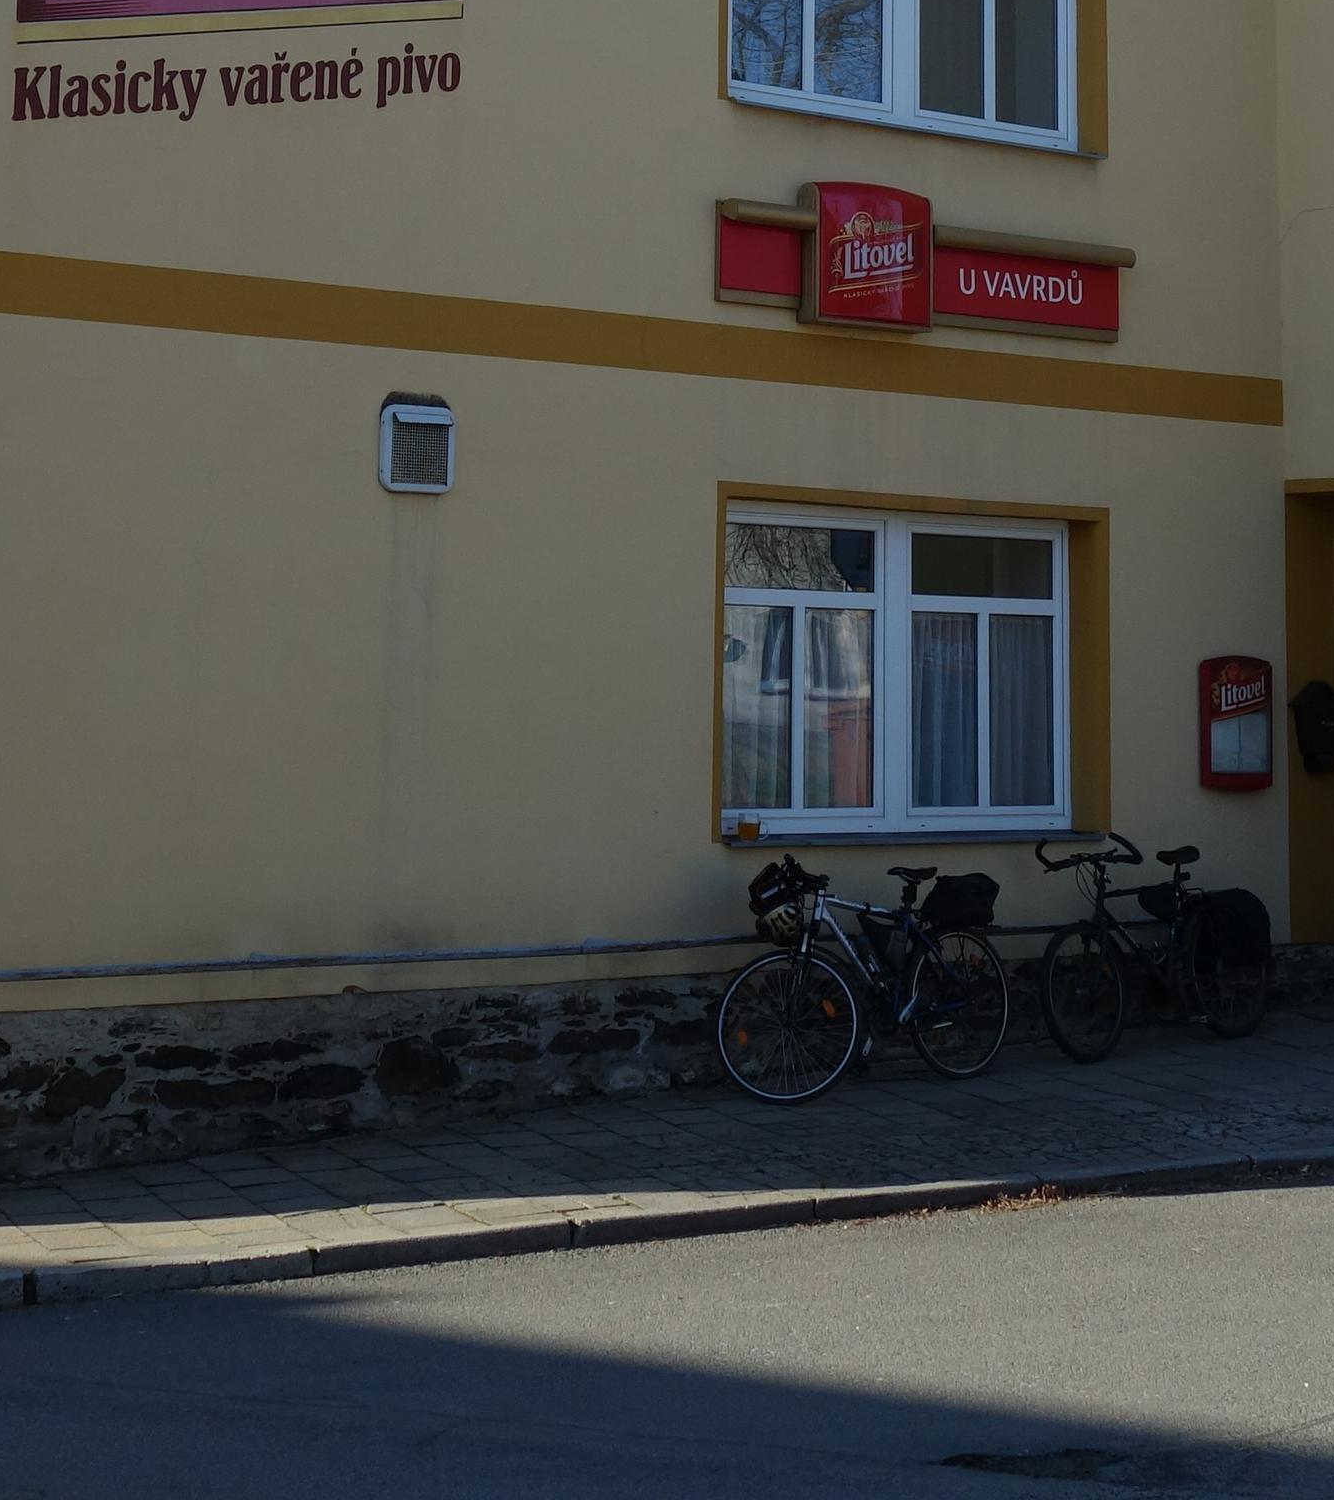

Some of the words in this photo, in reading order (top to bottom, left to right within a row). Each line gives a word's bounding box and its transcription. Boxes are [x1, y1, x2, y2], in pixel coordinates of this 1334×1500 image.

[12, 57, 207, 122] Klasicky
[219, 47, 363, 107] vařené
[376, 42, 462, 108] pivo
[843, 233, 915, 280] Litovel
[958, 267, 976, 295] U
[983, 269, 1084, 304] VAVRDŮ
[1220, 675, 1266, 712] Litovel
